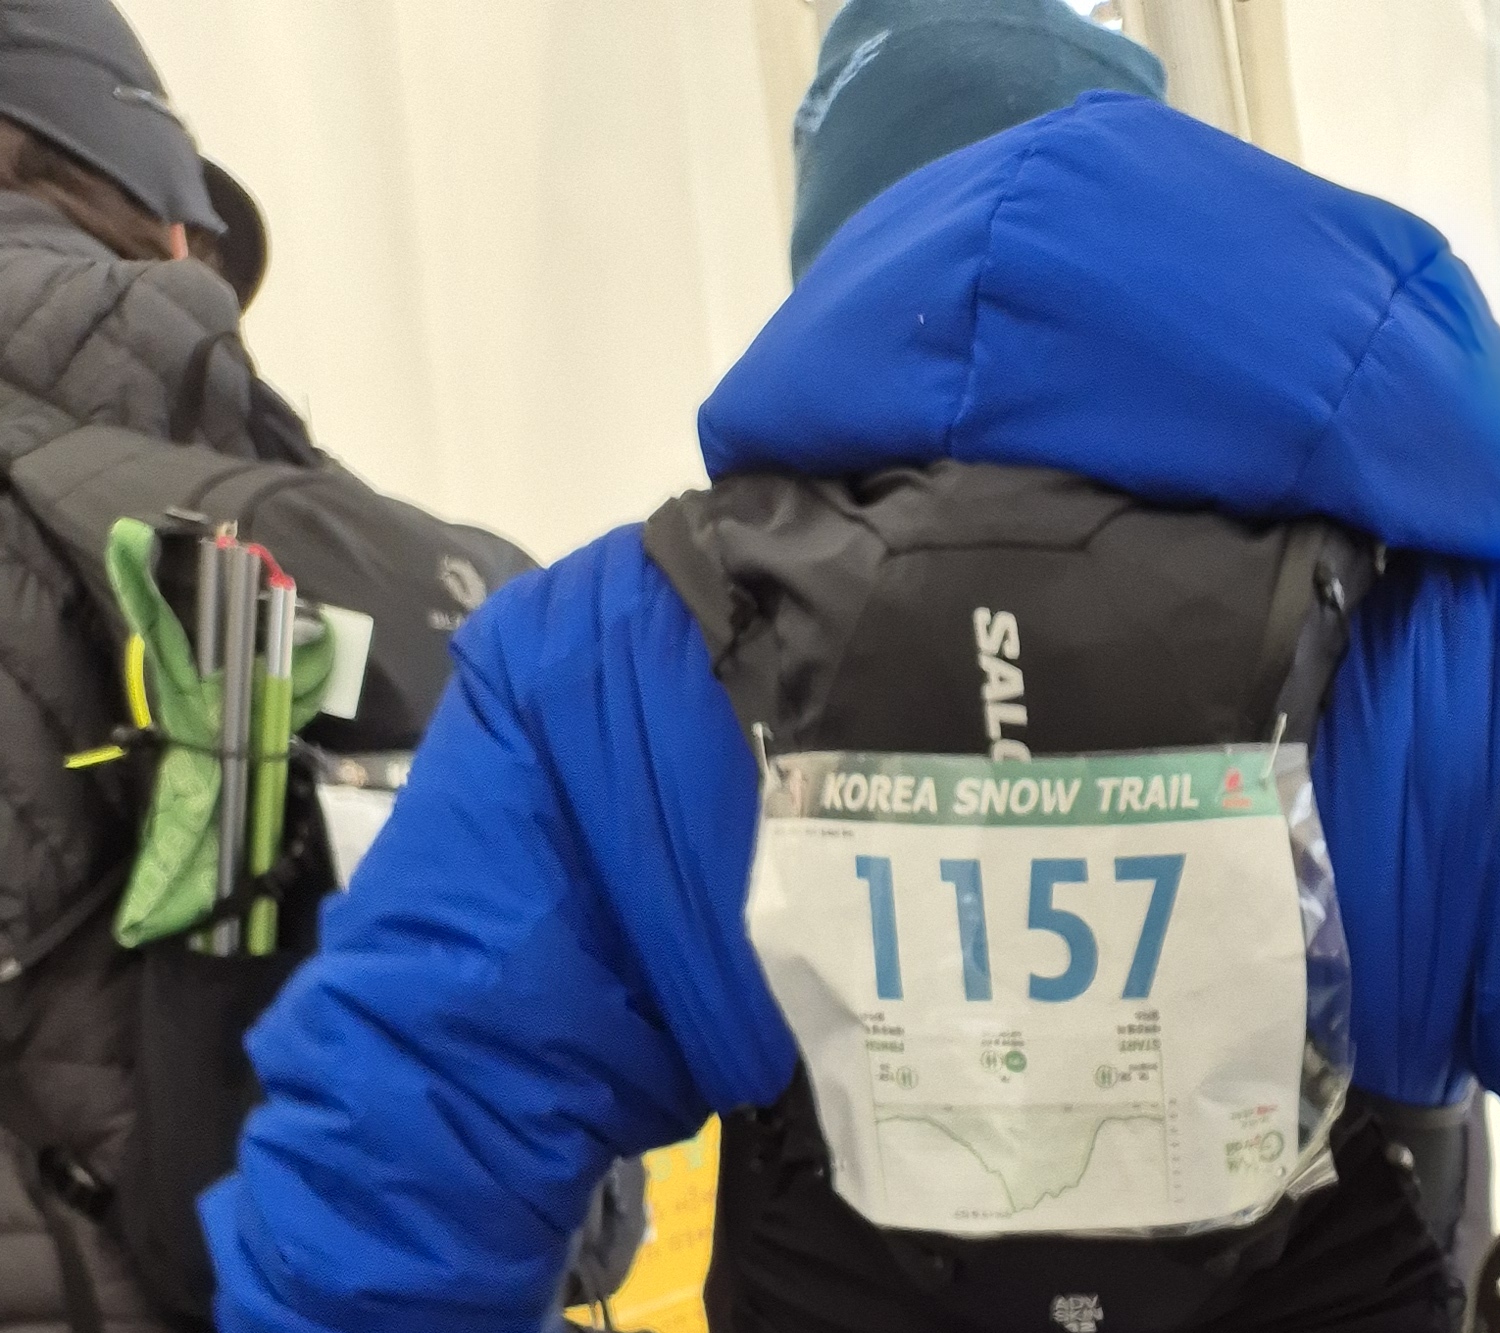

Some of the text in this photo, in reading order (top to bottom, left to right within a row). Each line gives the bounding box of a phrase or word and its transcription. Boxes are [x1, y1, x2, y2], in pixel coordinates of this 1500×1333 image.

[823, 773, 1199, 814] KOREA SNOW TRAIL
[855, 854, 1187, 1002] 1157
